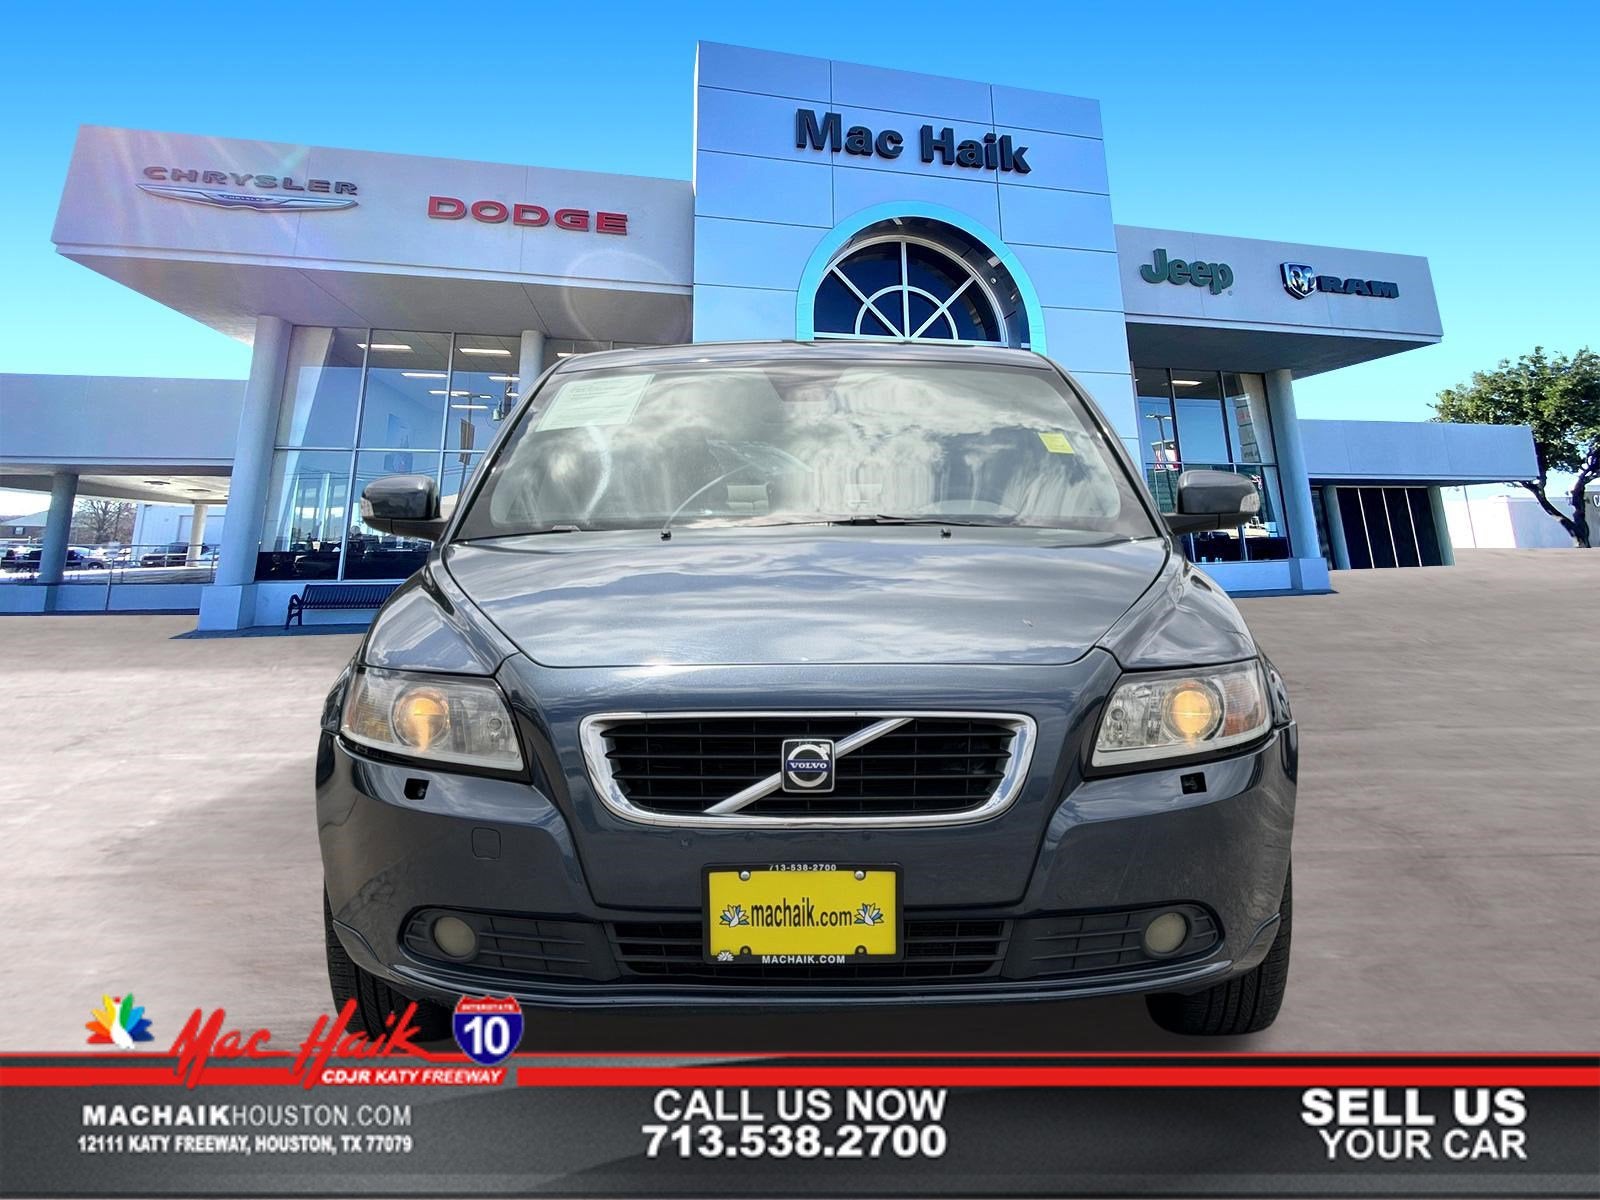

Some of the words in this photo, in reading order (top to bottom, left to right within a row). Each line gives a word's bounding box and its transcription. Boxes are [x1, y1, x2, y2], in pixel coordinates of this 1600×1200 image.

[795, 108, 904, 159] Mac
[919, 124, 1032, 174] Haik
[143, 165, 358, 196] CHRYSLER
[427, 195, 629, 236] DODGE
[1140, 248, 1234, 295] Jeep
[1316, 275, 1400, 299] RAM
[769, 863, 837, 872] 713-538-2700
[750, 897, 852, 927] machaik.com
[761, 954, 846, 964] MACHAIK.COM
